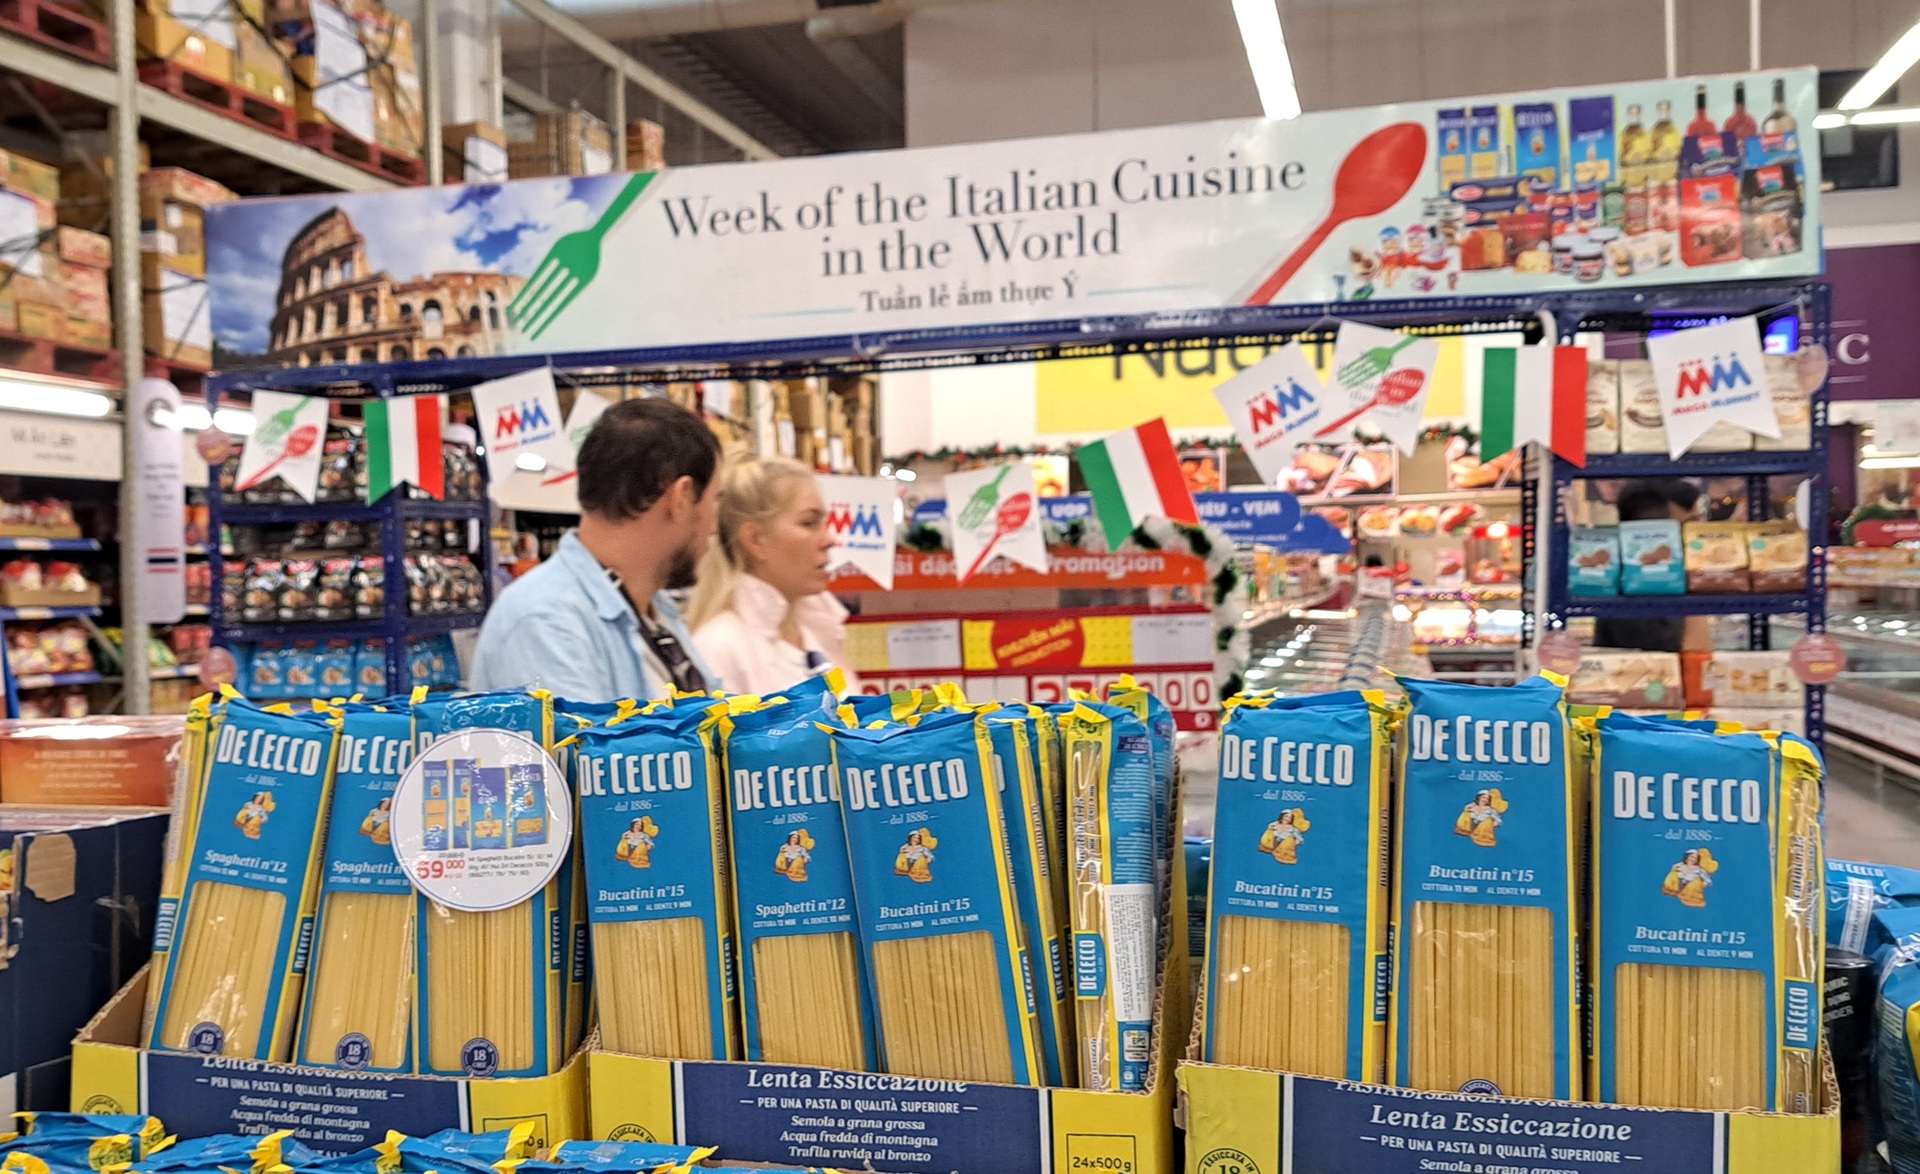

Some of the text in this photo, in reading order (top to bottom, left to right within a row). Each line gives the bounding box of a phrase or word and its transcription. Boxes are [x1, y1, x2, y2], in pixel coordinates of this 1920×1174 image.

[662, 151, 1305, 238] Week of the Italian Cuisine
[821, 212, 1121, 277] in the World
[860, 284, 922, 312] Tuần
[1000, 281, 1053, 305] thực
[1062, 269, 1079, 299] Ý
[216, 723, 322, 776] DE CECCO
[1413, 713, 1551, 765] DE CECCO
[336, 734, 367, 774] DE
[1222, 734, 1354, 787] DE CECCO
[578, 751, 692, 796] DE CECCO
[846, 758, 969, 811] DE CECCO
[734, 769, 765, 811] DE
[1613, 770, 1761, 825] DE CECCO
[205, 850, 288, 872] Spaghetti n°12
[332, 860, 393, 875] Spaghetti
[1429, 864, 1535, 883] Bucatini n°15
[598, 884, 685, 901] Bucatini n°15
[1235, 880, 1333, 900] Bucatini n°15
[755, 898, 846, 918] Spaghetti n°12
[880, 897, 971, 919] Bucatini n°15
[1635, 925, 1746, 945] Bucatini n°15
[1078, 939, 1097, 991] DE CECCO
[1786, 986, 1808, 1042] DE CECCO
[347, 1043, 361, 1056] 18
[473, 1049, 487, 1061] 18
[210, 1076, 388, 1100] PER UNA PASTA DI QUALITÀ SUPERIORE
[747, 1069, 812, 1088] Lenta
[239, 1095, 279, 1108] Semola
[288, 1101, 320, 1114] grana
[321, 1104, 358, 1116] grossa
[757, 1097, 960, 1114] PER UNA PASTA DI QUALITÀ SUPERIORE
[230, 1109, 370, 1131] Acqua fredda di montagna
[791, 1115, 926, 1133] Semola a grana grossa
[1370, 1104, 1632, 1141] Lenta Essiccazione
[325, 1128, 364, 1143] bronzo
[780, 1130, 938, 1148] Acqua fredda di montagna
[788, 1146, 932, 1162] Trafila ruvida al bronzo
[1203, 1151, 1245, 1168] ESSICCATA
[1381, 1134, 1621, 1164] PER UNA PASTA DI QUALITÀ SUPERIORE
[1072, 1156, 1132, 1172] 24x500 g
[1419, 1158, 1472, 1172] Semola
[1474, 1163, 1484, 1173] a
[1485, 1165, 1530, 1174] grana
